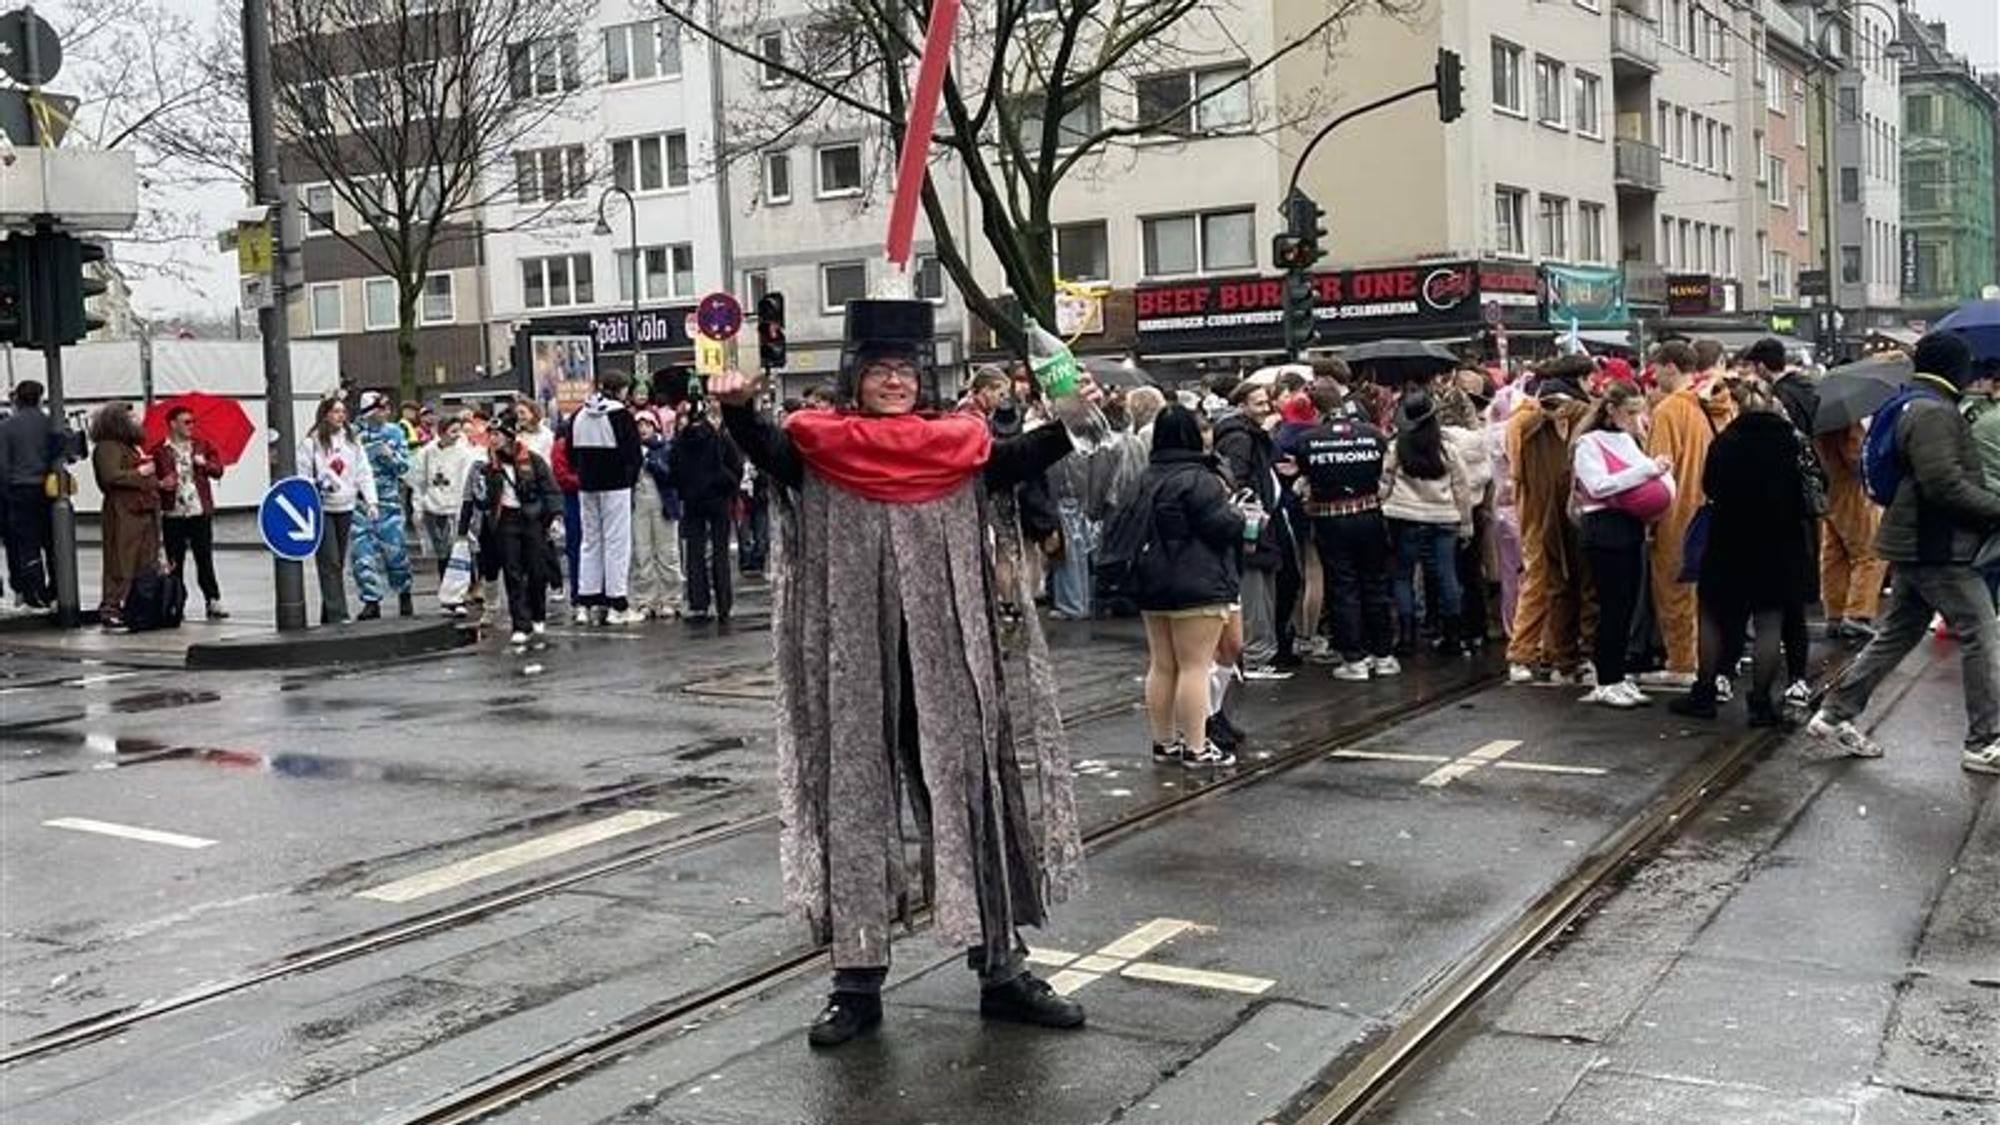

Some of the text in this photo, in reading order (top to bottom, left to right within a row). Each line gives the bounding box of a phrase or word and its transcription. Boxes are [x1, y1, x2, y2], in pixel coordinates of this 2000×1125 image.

[1138, 272, 1418, 315] BEEF BURR ONE
[634, 313, 667, 342] öln
[704, 347, 721, 366] H
